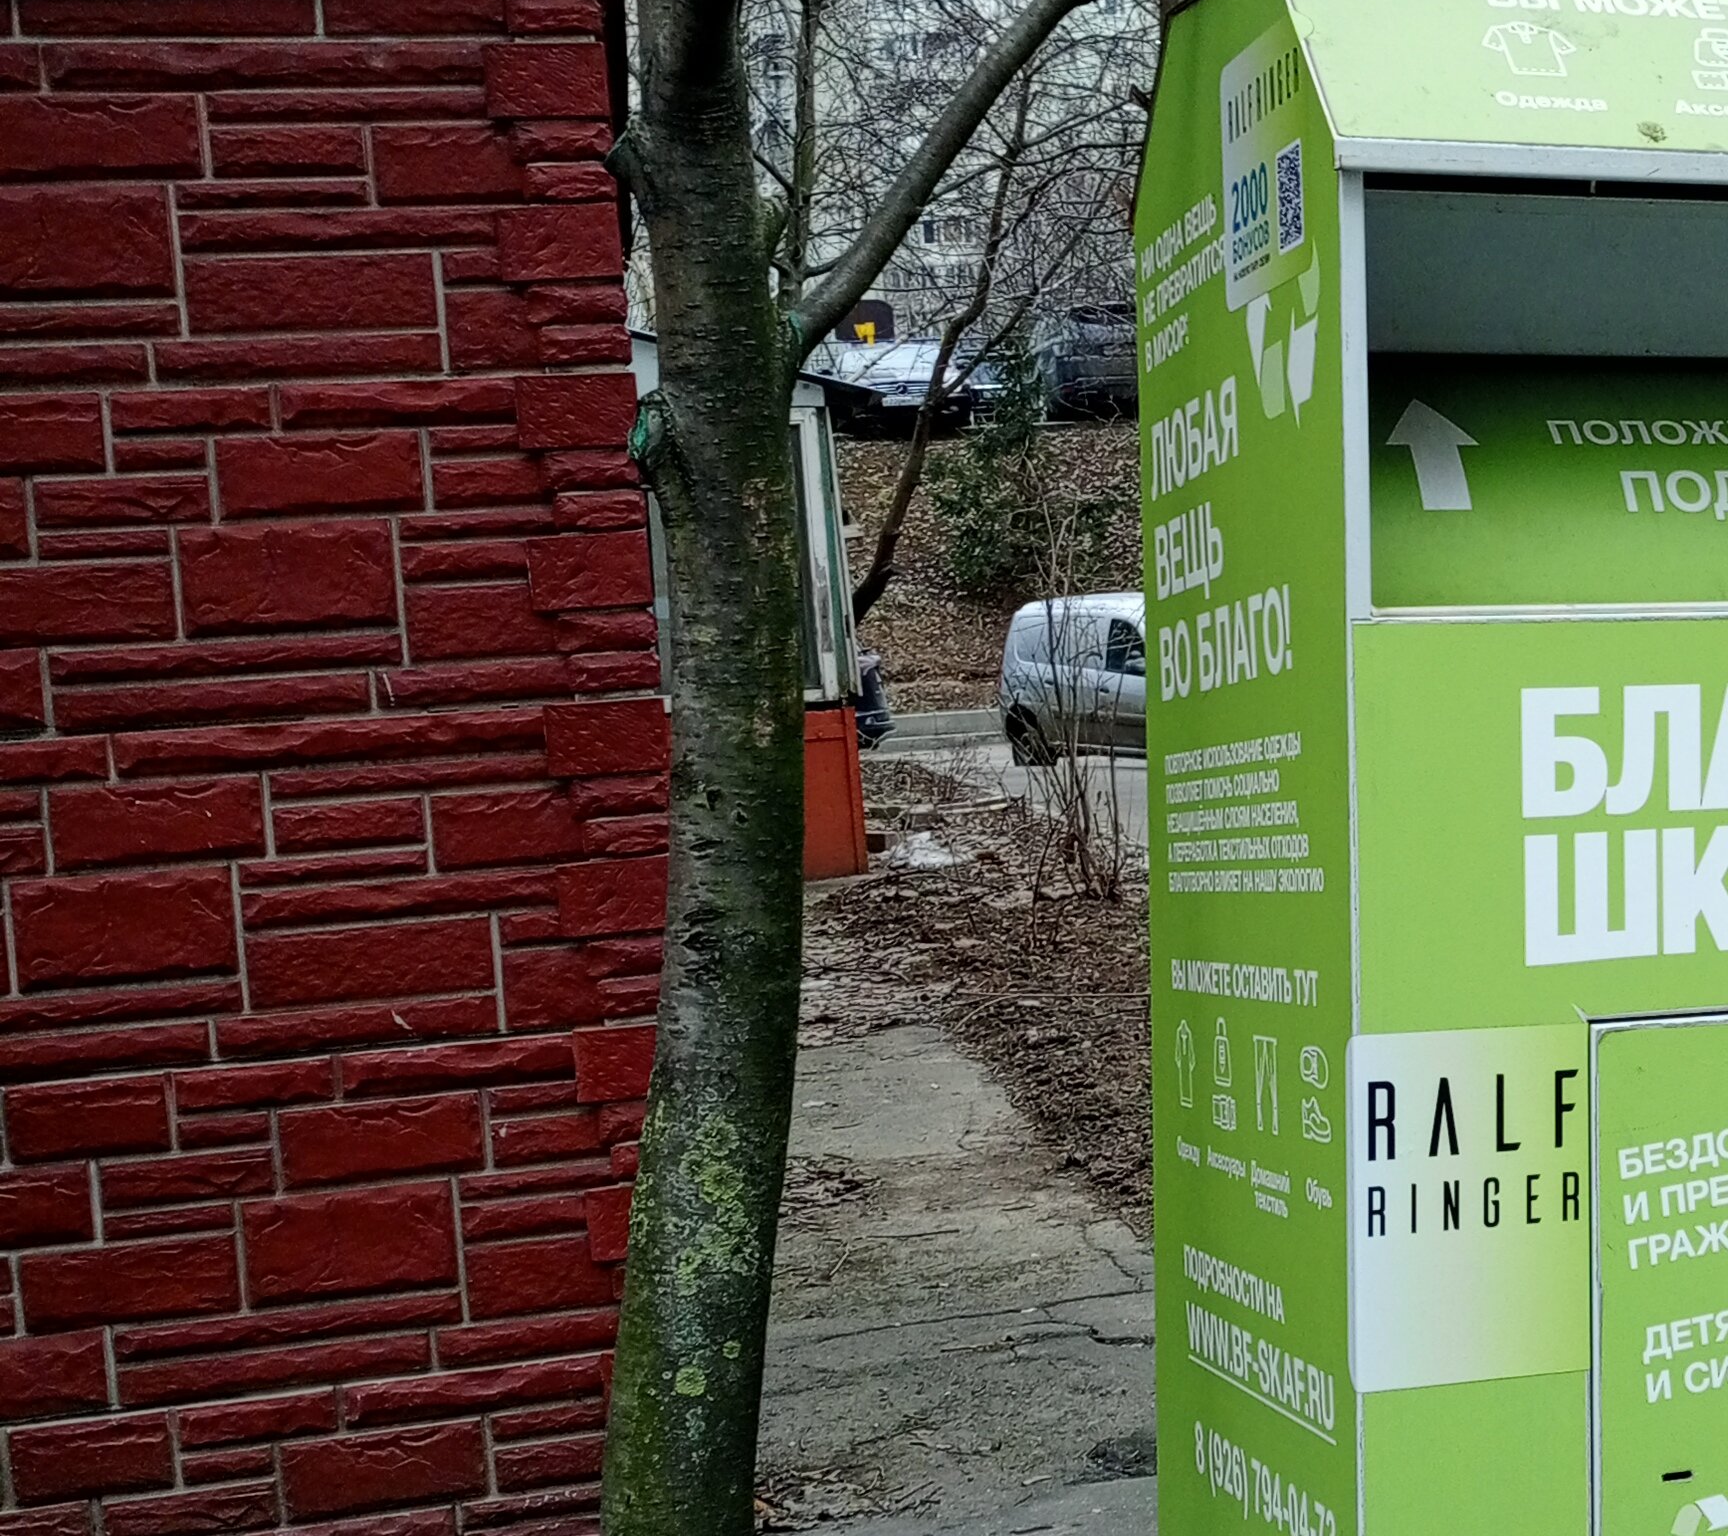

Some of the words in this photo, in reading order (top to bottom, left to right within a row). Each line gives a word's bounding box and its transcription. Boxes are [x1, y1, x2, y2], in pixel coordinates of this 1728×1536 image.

[1495, 90, 1608, 112] Одежда
[1231, 161, 1268, 234] 2000
[1141, 243, 1155, 283] НИ
[1155, 219, 1185, 272] ОДНА
[1184, 193, 1217, 246] ВЕЩЬ
[1232, 220, 1269, 265] БОНУСОВ
[1143, 289, 1156, 328] НЕ
[1156, 233, 1226, 317] ПРЕВРАТИТСЯ
[1145, 340, 1153, 374] В
[1151, 375, 1239, 502] ЛЮБАЯ
[1154, 501, 1224, 601] ВЕЩЬ
[1158, 619, 1192, 702] ВО
[1196, 584, 1293, 693] БЛАГО!
[1263, 731, 1301, 764] ОДЕЖДЫ
[1233, 768, 1280, 800] СОЦИАЛЬНО
[1271, 833, 1310, 863] ОТХОДОВ
[1278, 867, 1324, 892] ЭКОЛОГИЮ
[1171, 959, 1186, 991] ВЫ
[1187, 960, 1231, 996] МОЖЕТЕ
[1232, 963, 1292, 1004] ОСТАВИТЬ
[1293, 969, 1318, 1007] ТУТ
[1368, 1069, 1579, 1161] RALF
[1251, 1159, 1290, 1194] Домашний
[1306, 1177, 1333, 1211] Обувь
[1254, 1190, 1289, 1219] текстиль
[1368, 1171, 1580, 1238] RINGER
[1623, 1195, 1651, 1226] И
[1183, 1244, 1265, 1315] ПОДРОБНОСТИ
[1266, 1281, 1285, 1324] НА
[1185, 1300, 1335, 1431] WWW.BF-SKAF.RU
[1645, 1371, 1673, 1404] И
[1194, 1420, 1205, 1474] 8
[1209, 1428, 1248, 1521] (926)
